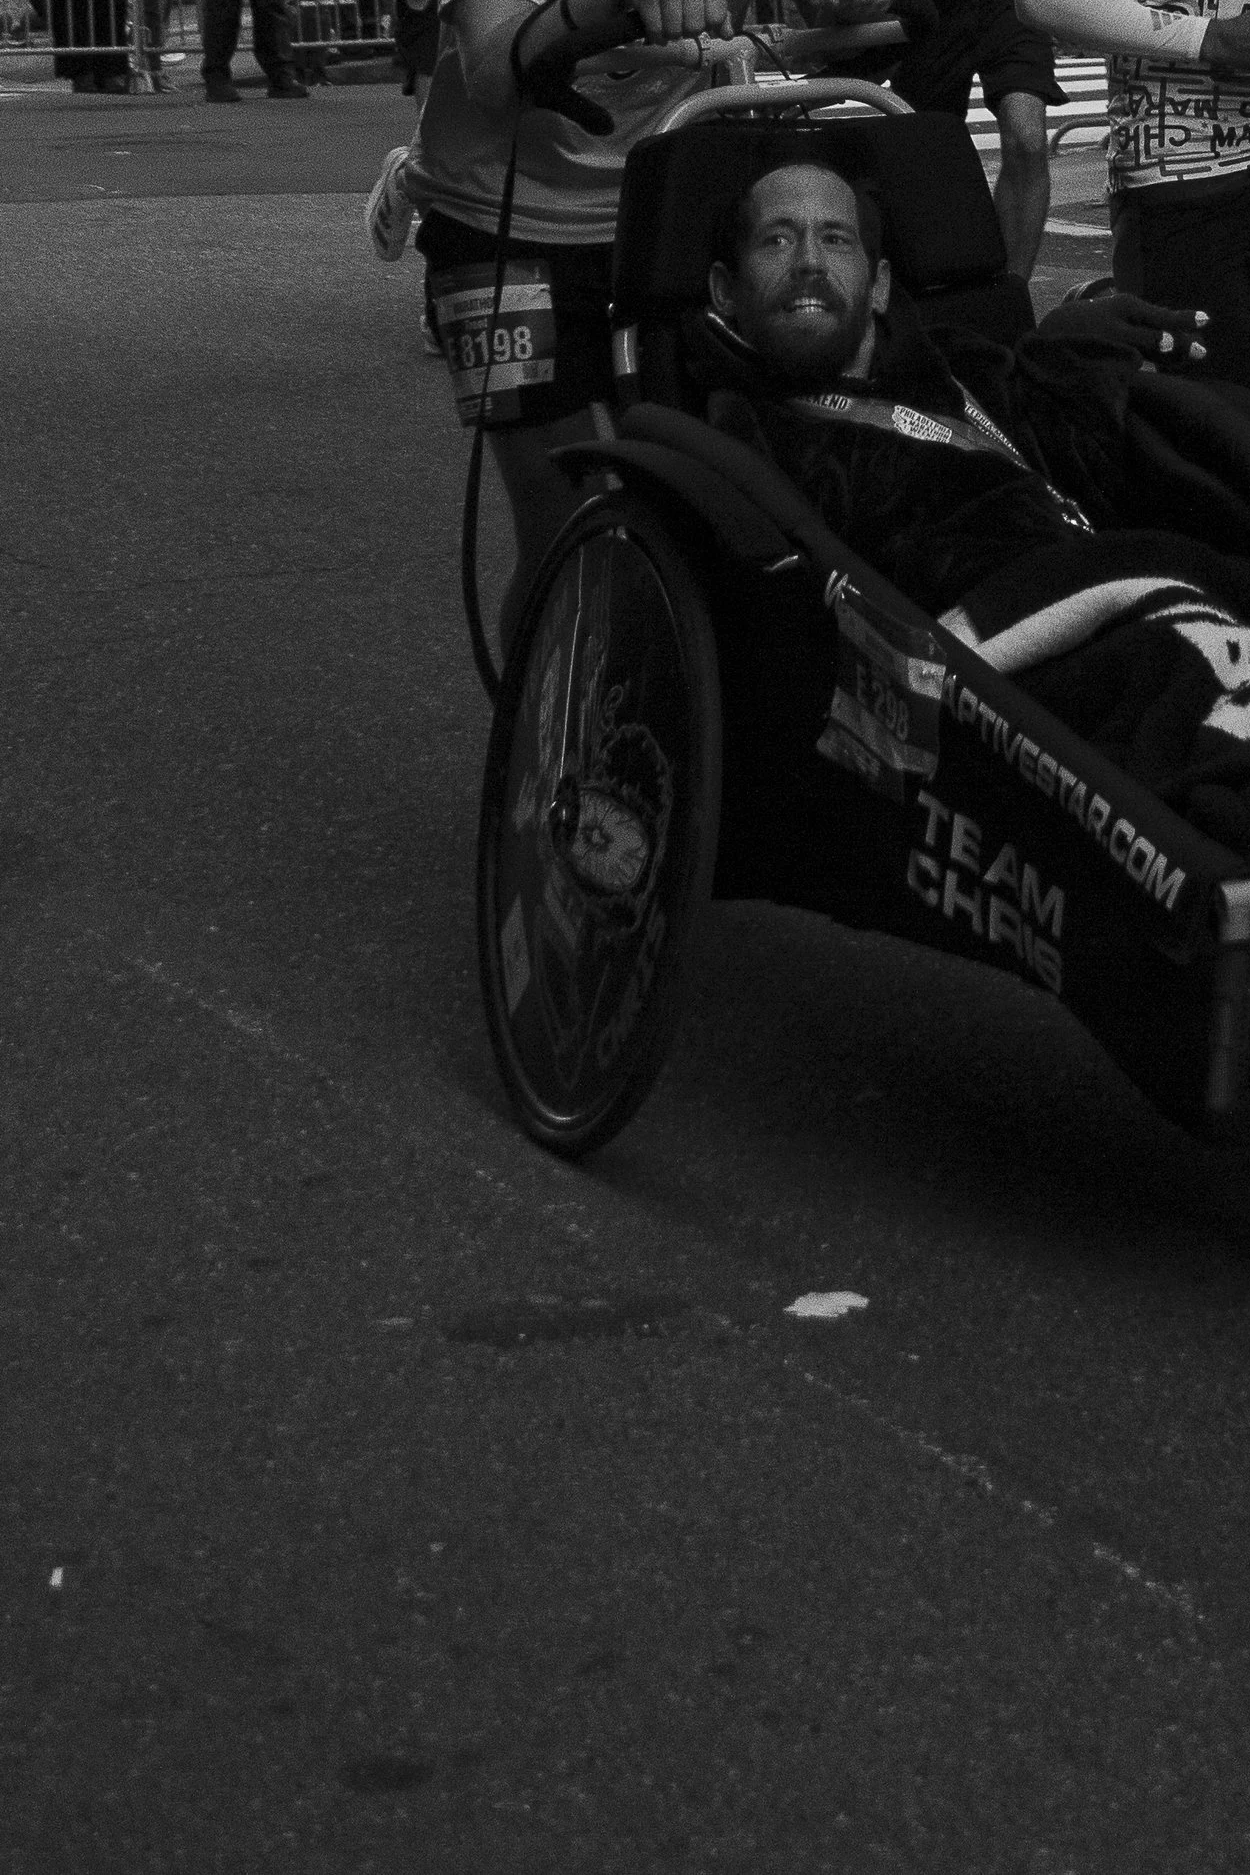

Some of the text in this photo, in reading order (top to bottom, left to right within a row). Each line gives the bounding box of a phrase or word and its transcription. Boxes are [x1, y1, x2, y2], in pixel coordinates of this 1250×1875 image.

[453, 297, 496, 315] MARATHO
[460, 326, 534, 367] 8198
[898, 406, 951, 436] PHILADELPHIA
[917, 788, 1065, 940] TEAM
[906, 847, 1064, 997] CHRIS
